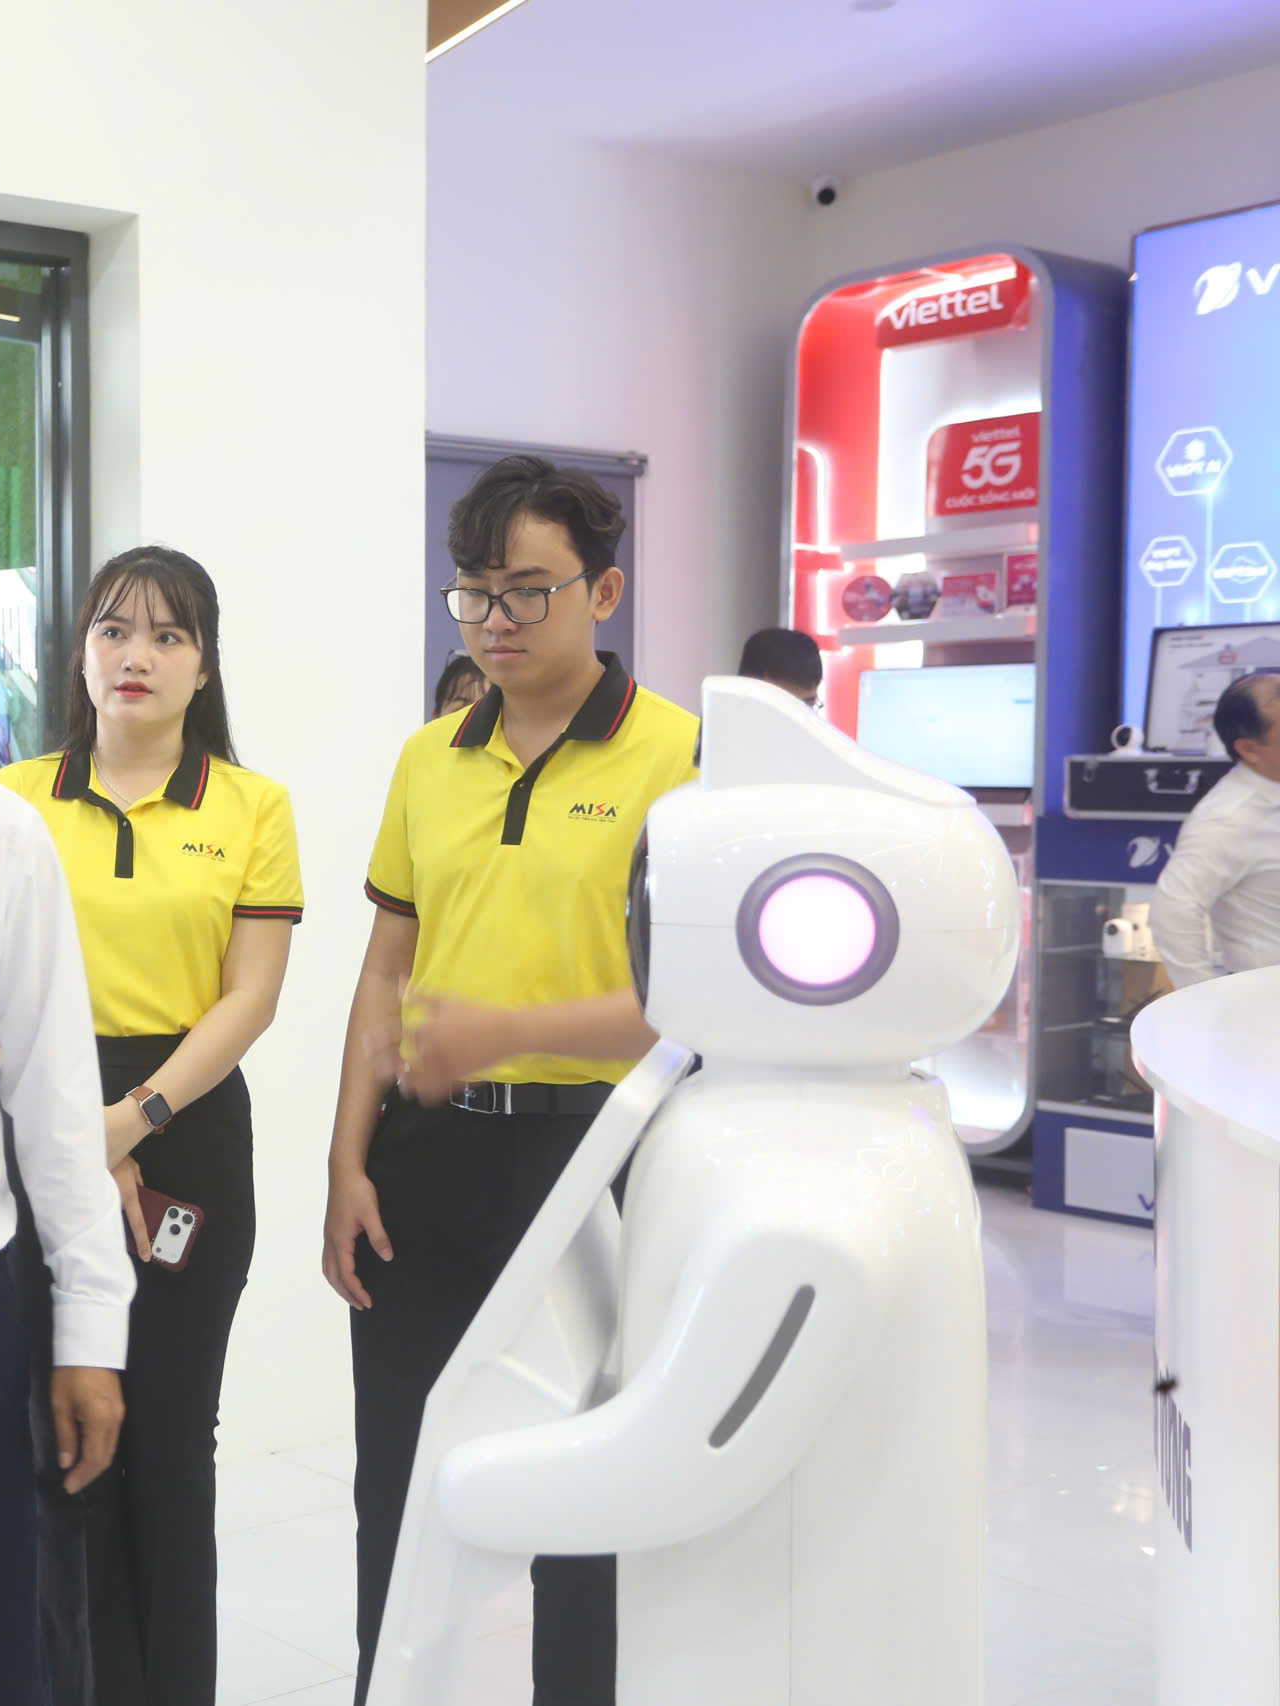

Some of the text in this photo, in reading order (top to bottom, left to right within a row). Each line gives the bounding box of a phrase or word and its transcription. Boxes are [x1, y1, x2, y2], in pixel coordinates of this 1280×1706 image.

[889, 285, 1004, 330] viettel
[961, 439, 1022, 489] 5G
[568, 802, 618, 817] MISA
[181, 842, 226, 858] MISA
